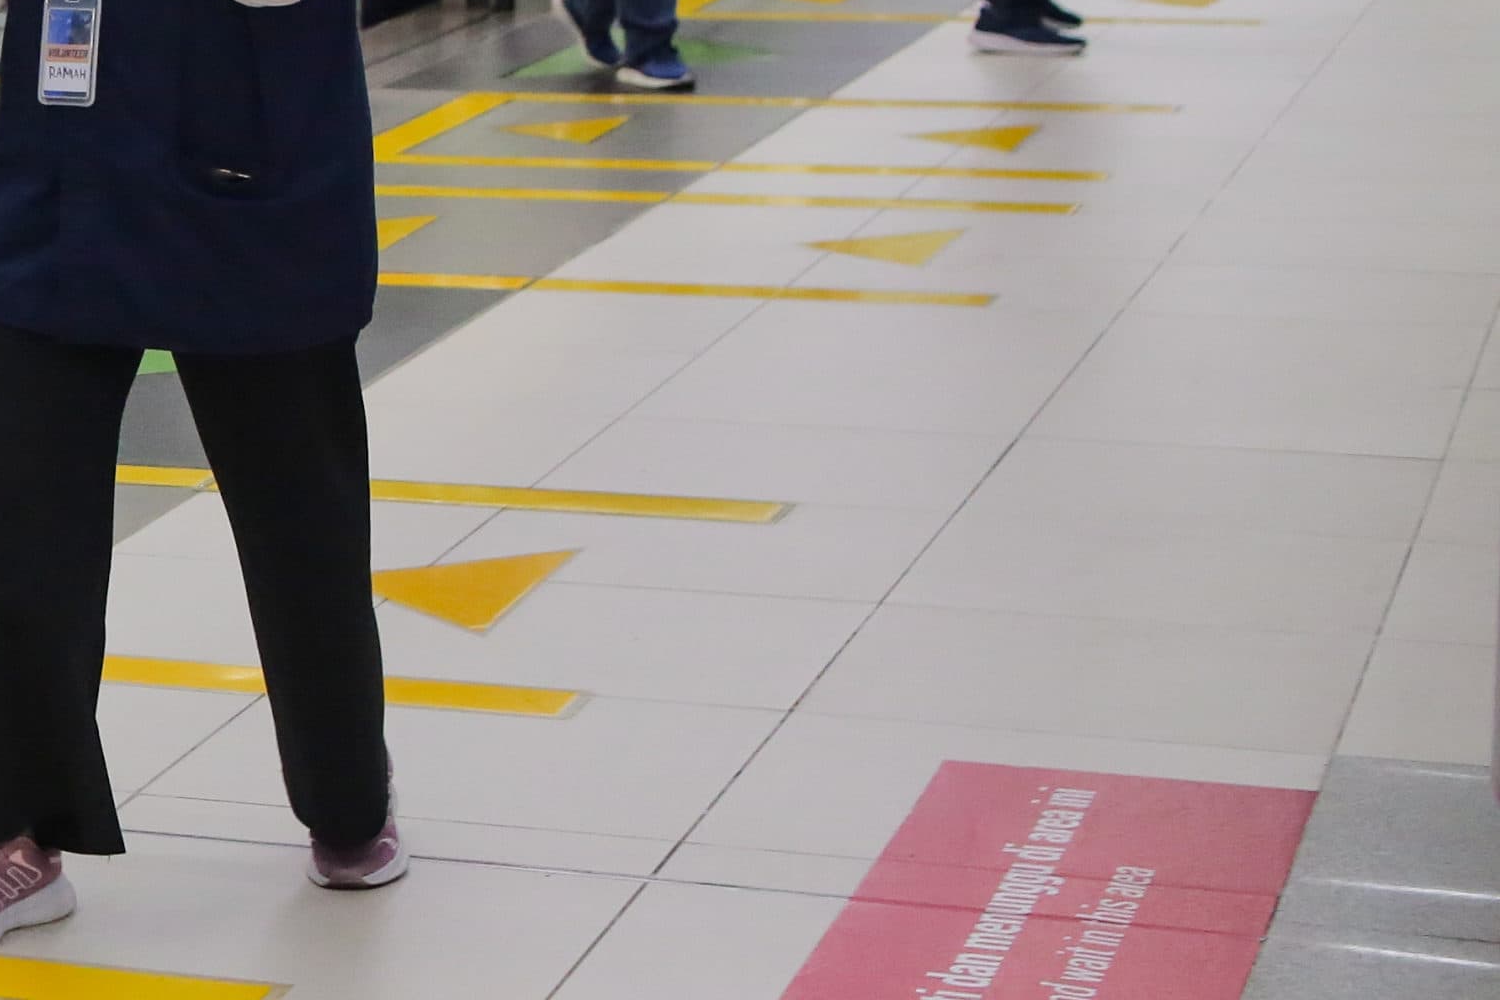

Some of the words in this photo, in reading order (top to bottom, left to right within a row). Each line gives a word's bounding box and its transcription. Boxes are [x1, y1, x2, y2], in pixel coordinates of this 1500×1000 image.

[1030, 786, 1097, 809] ini
[1028, 809, 1084, 843] area
[1002, 843, 1067, 861] di
[1105, 866, 1156, 898] area
[964, 863, 1067, 951] menunggu
[1075, 899, 1139, 928] this
[1063, 930, 1125, 947] in
[926, 953, 1004, 988] dan
[1056, 946, 1116, 982] wait
